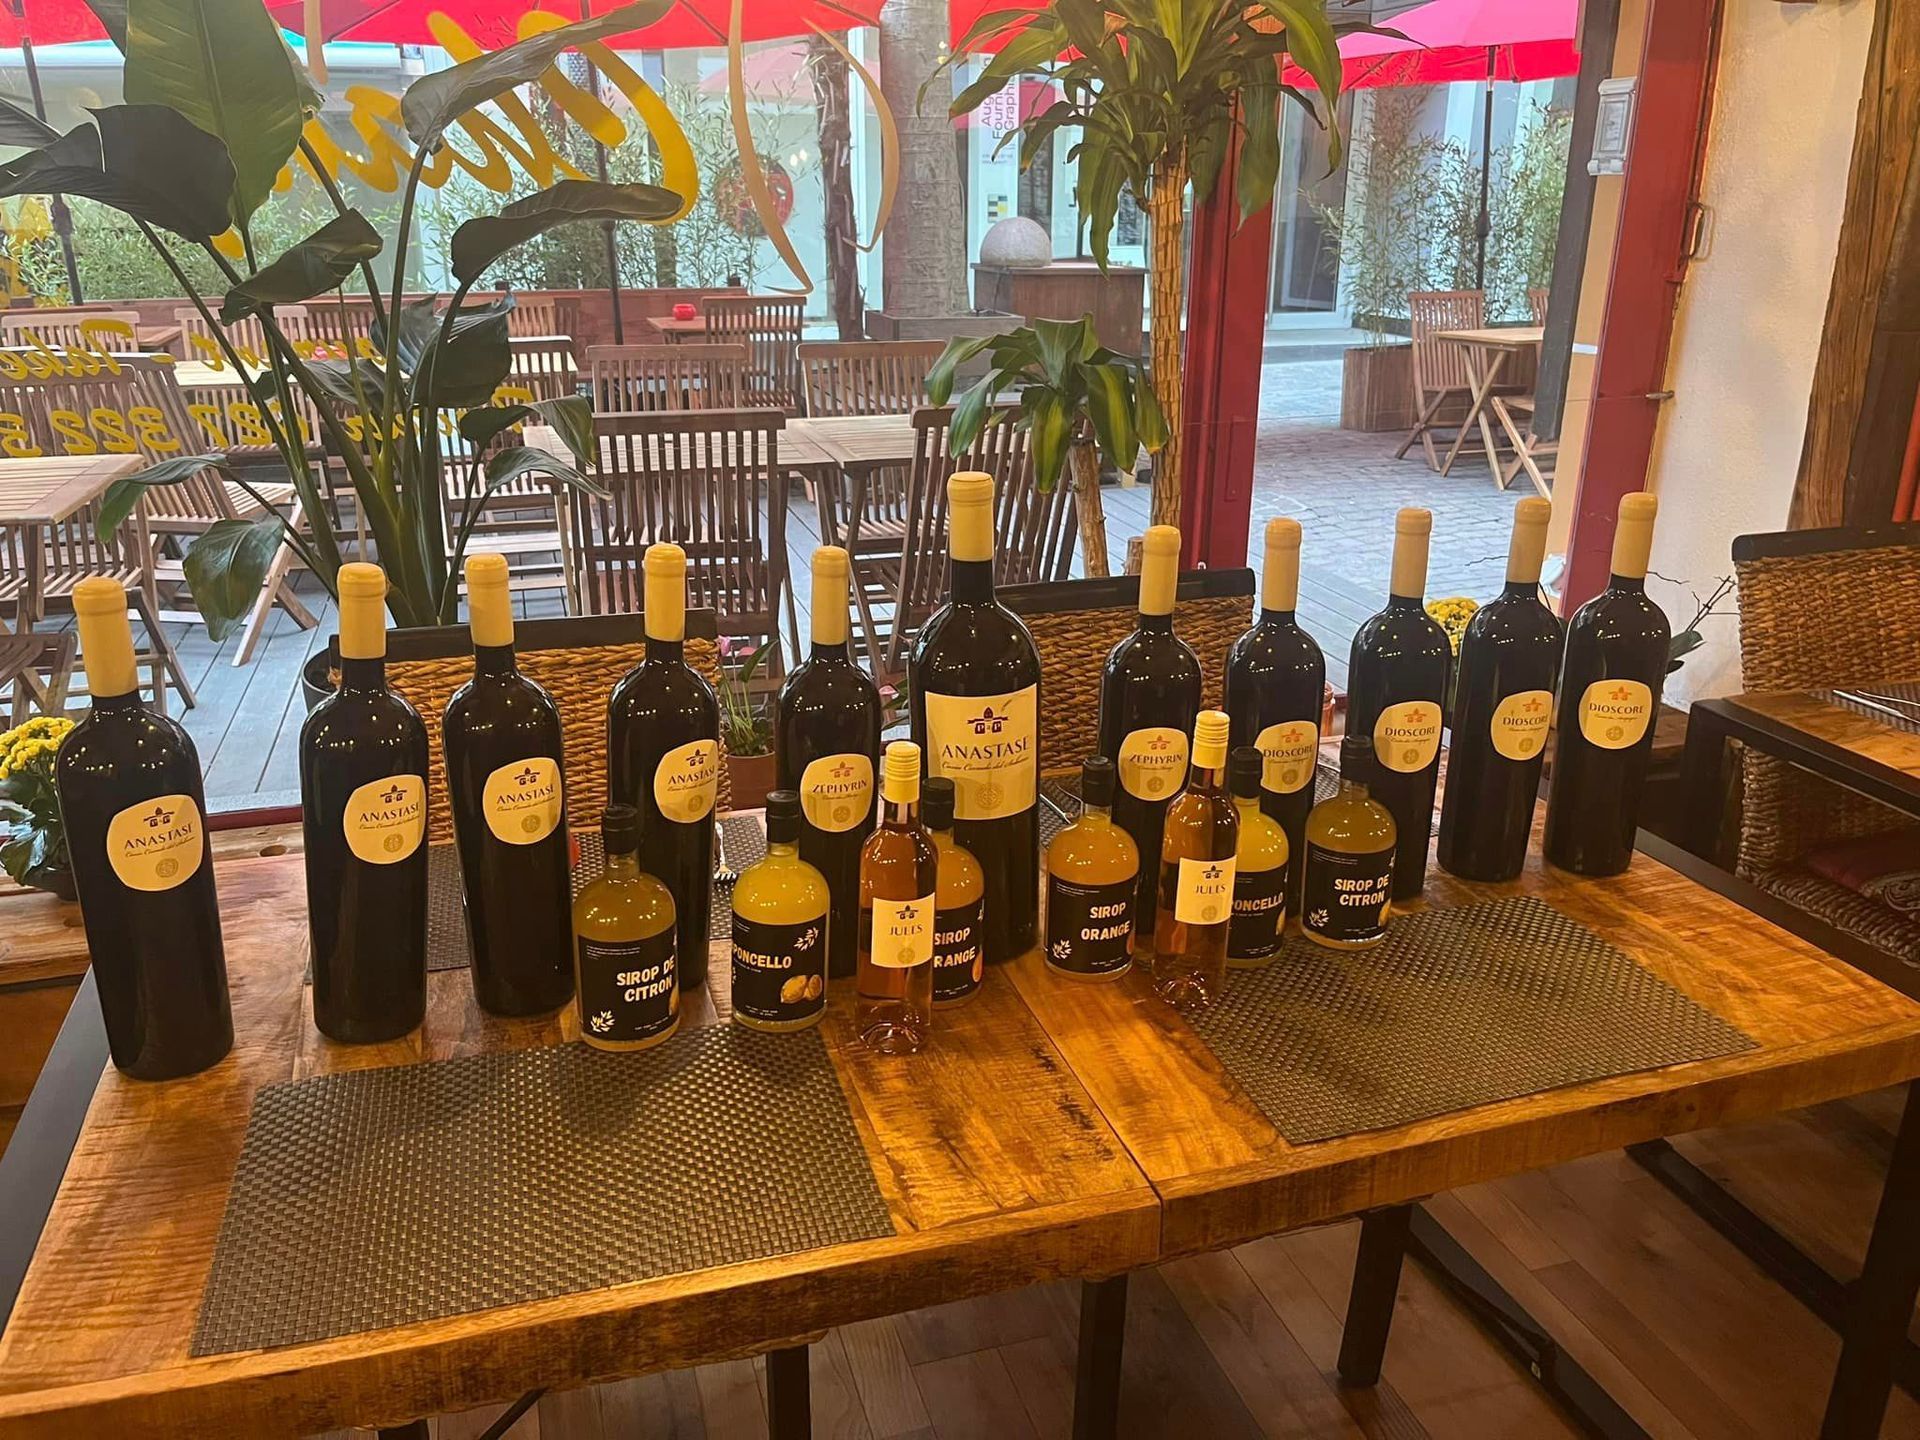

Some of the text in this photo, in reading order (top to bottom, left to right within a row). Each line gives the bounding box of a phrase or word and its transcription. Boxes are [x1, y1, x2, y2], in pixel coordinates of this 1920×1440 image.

[942, 735, 1032, 760] ANASTASE
[1334, 874, 1390, 891] SIROP DE
[1232, 892, 1284, 912] ONCELLO
[1339, 890, 1385, 906] CITRON
[1089, 902, 1127, 919] SIROP
[934, 927, 971, 946] SIROP
[1080, 920, 1131, 941] ORANGE
[933, 946, 976, 968] RANGE
[616, 954, 675, 986] SIROP DE
[624, 974, 673, 1002] CITRON
